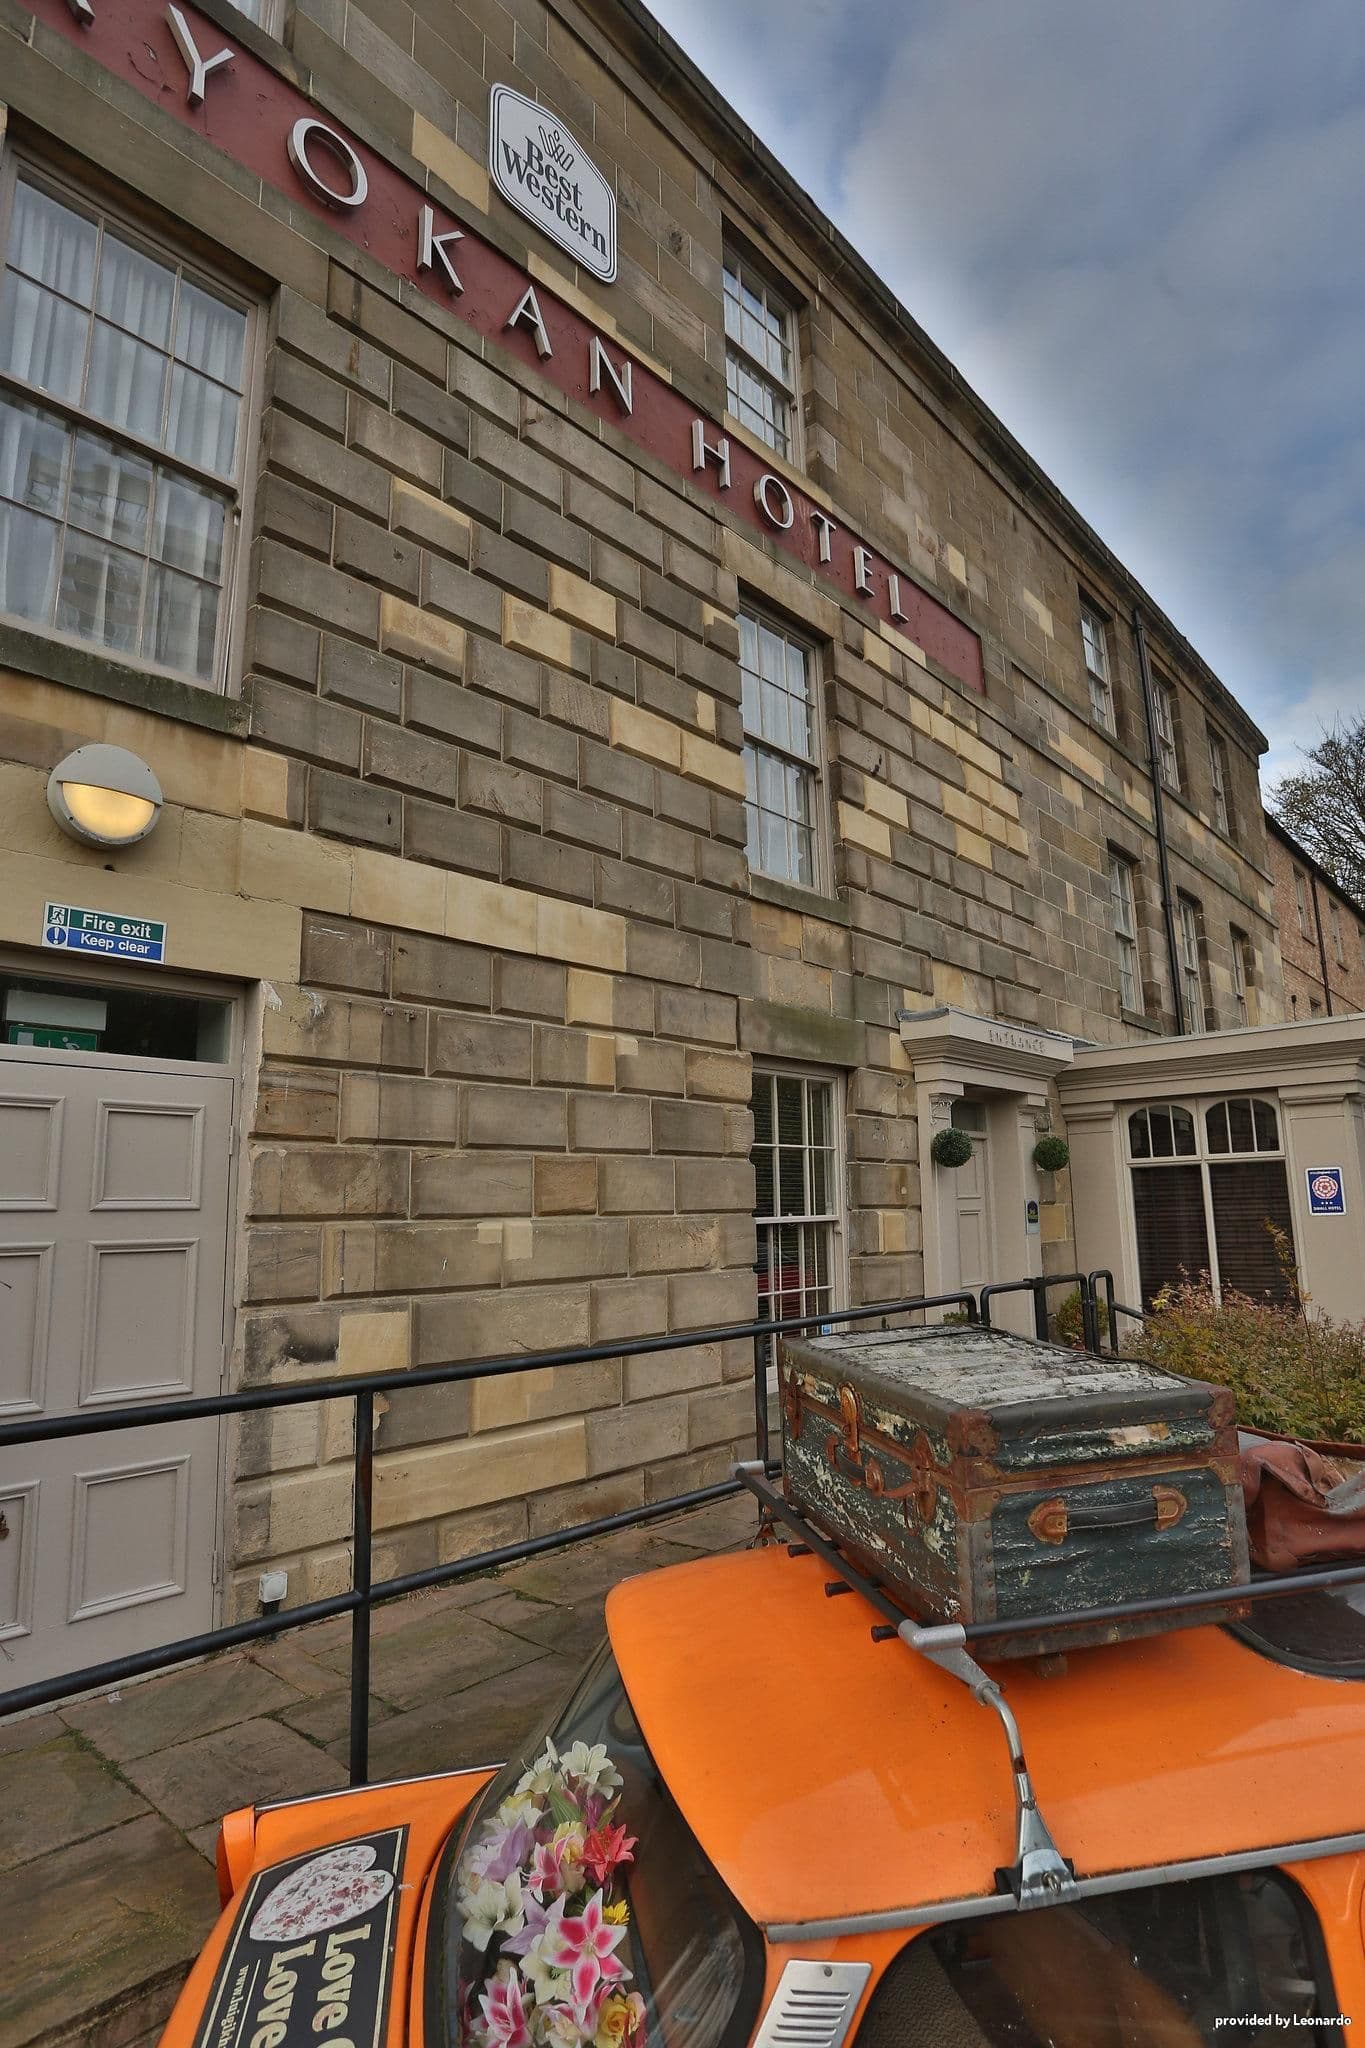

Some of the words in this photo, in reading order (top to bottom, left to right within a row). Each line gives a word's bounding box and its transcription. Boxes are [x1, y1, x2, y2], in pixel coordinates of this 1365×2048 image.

[501, 138, 608, 258] Western
[525, 136, 583, 211] Best
[68, 0, 633, 417] YOKAN
[692, 419, 909, 624] HOTEL
[80, 932, 114, 950] Keep
[118, 940, 150, 954] clear
[82, 913, 116, 932] Fire
[121, 923, 152, 938] exit
[217, 1965, 250, 2048] www.luigikh
[250, 1940, 317, 2048] Love
[312, 1924, 372, 2032] Love
